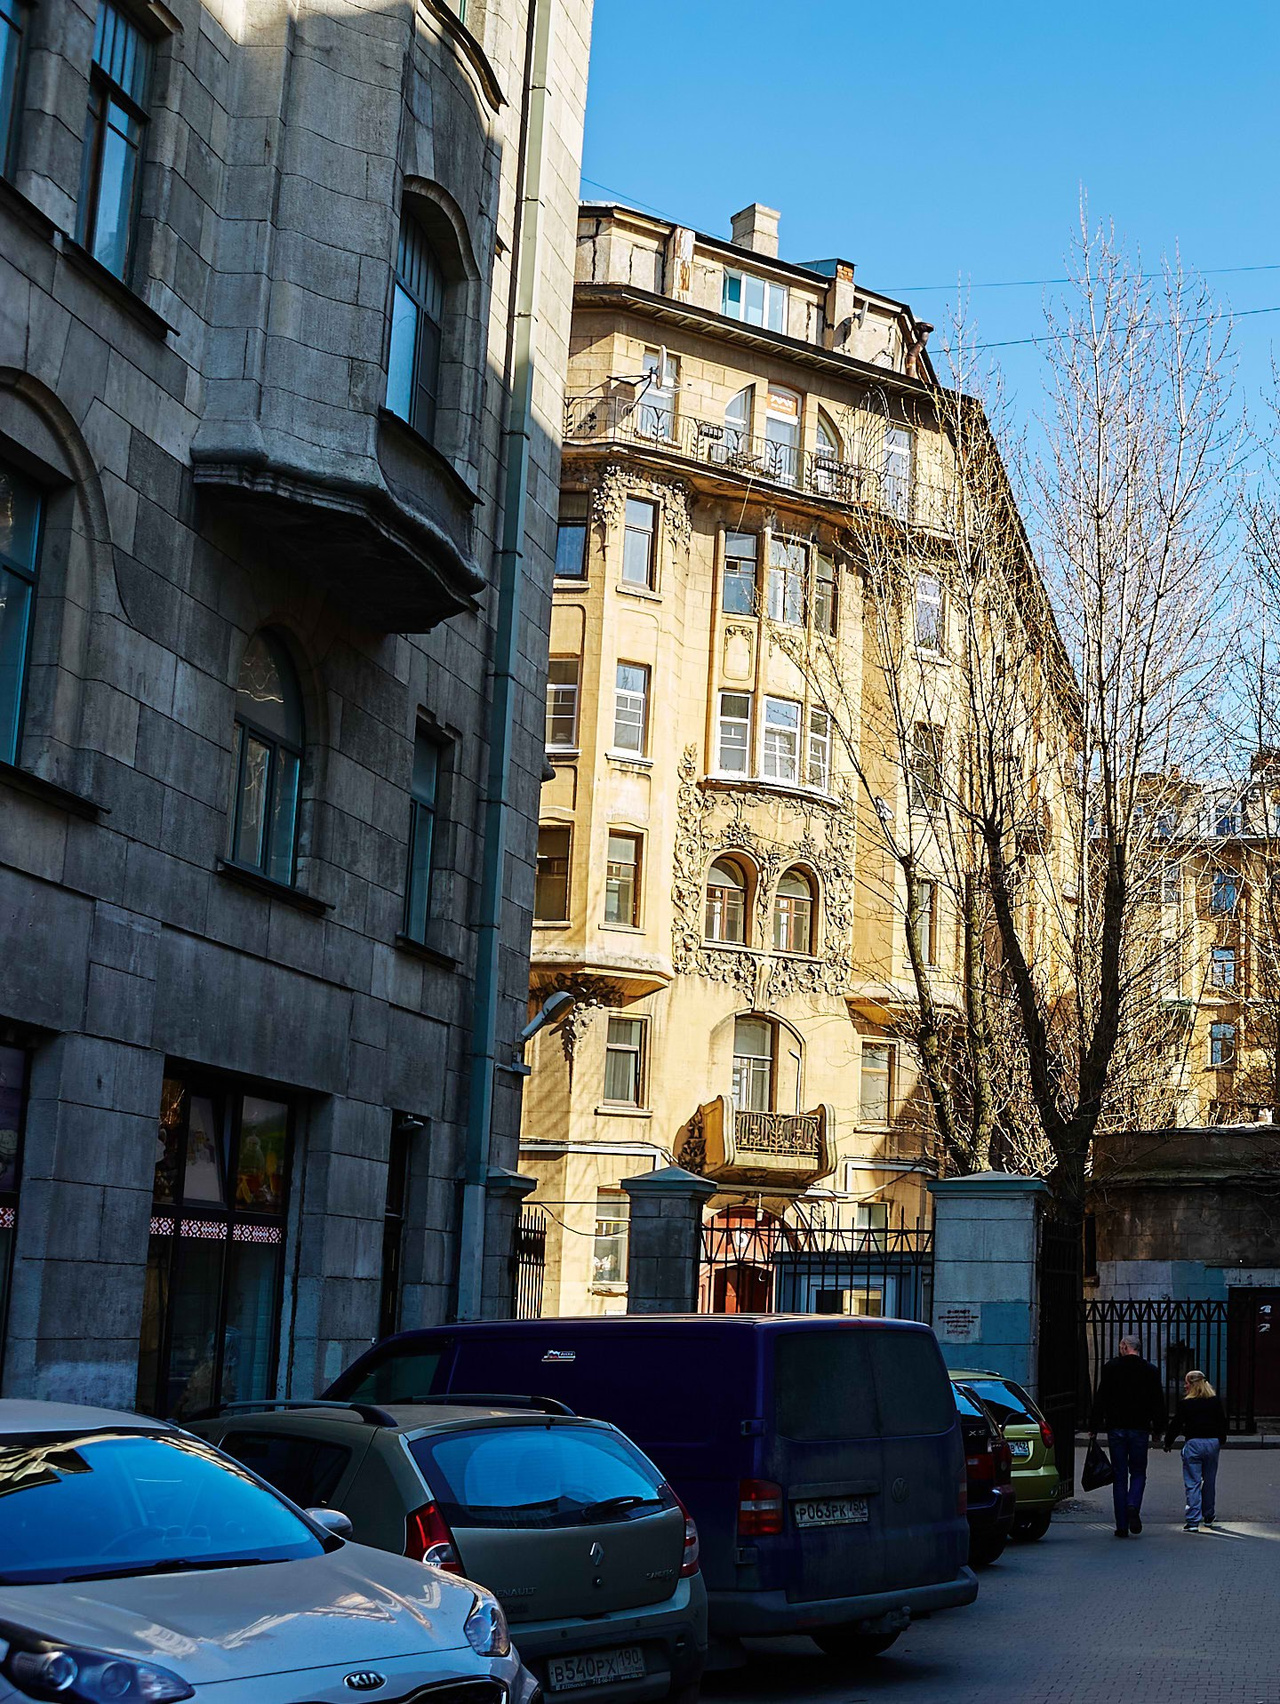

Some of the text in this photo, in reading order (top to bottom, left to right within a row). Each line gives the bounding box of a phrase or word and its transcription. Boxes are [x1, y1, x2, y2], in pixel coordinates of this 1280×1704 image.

[554, 1656, 616, 1683] В540РХ
[618, 1649, 639, 1666] 190
[350, 1673, 381, 1686] KIA
